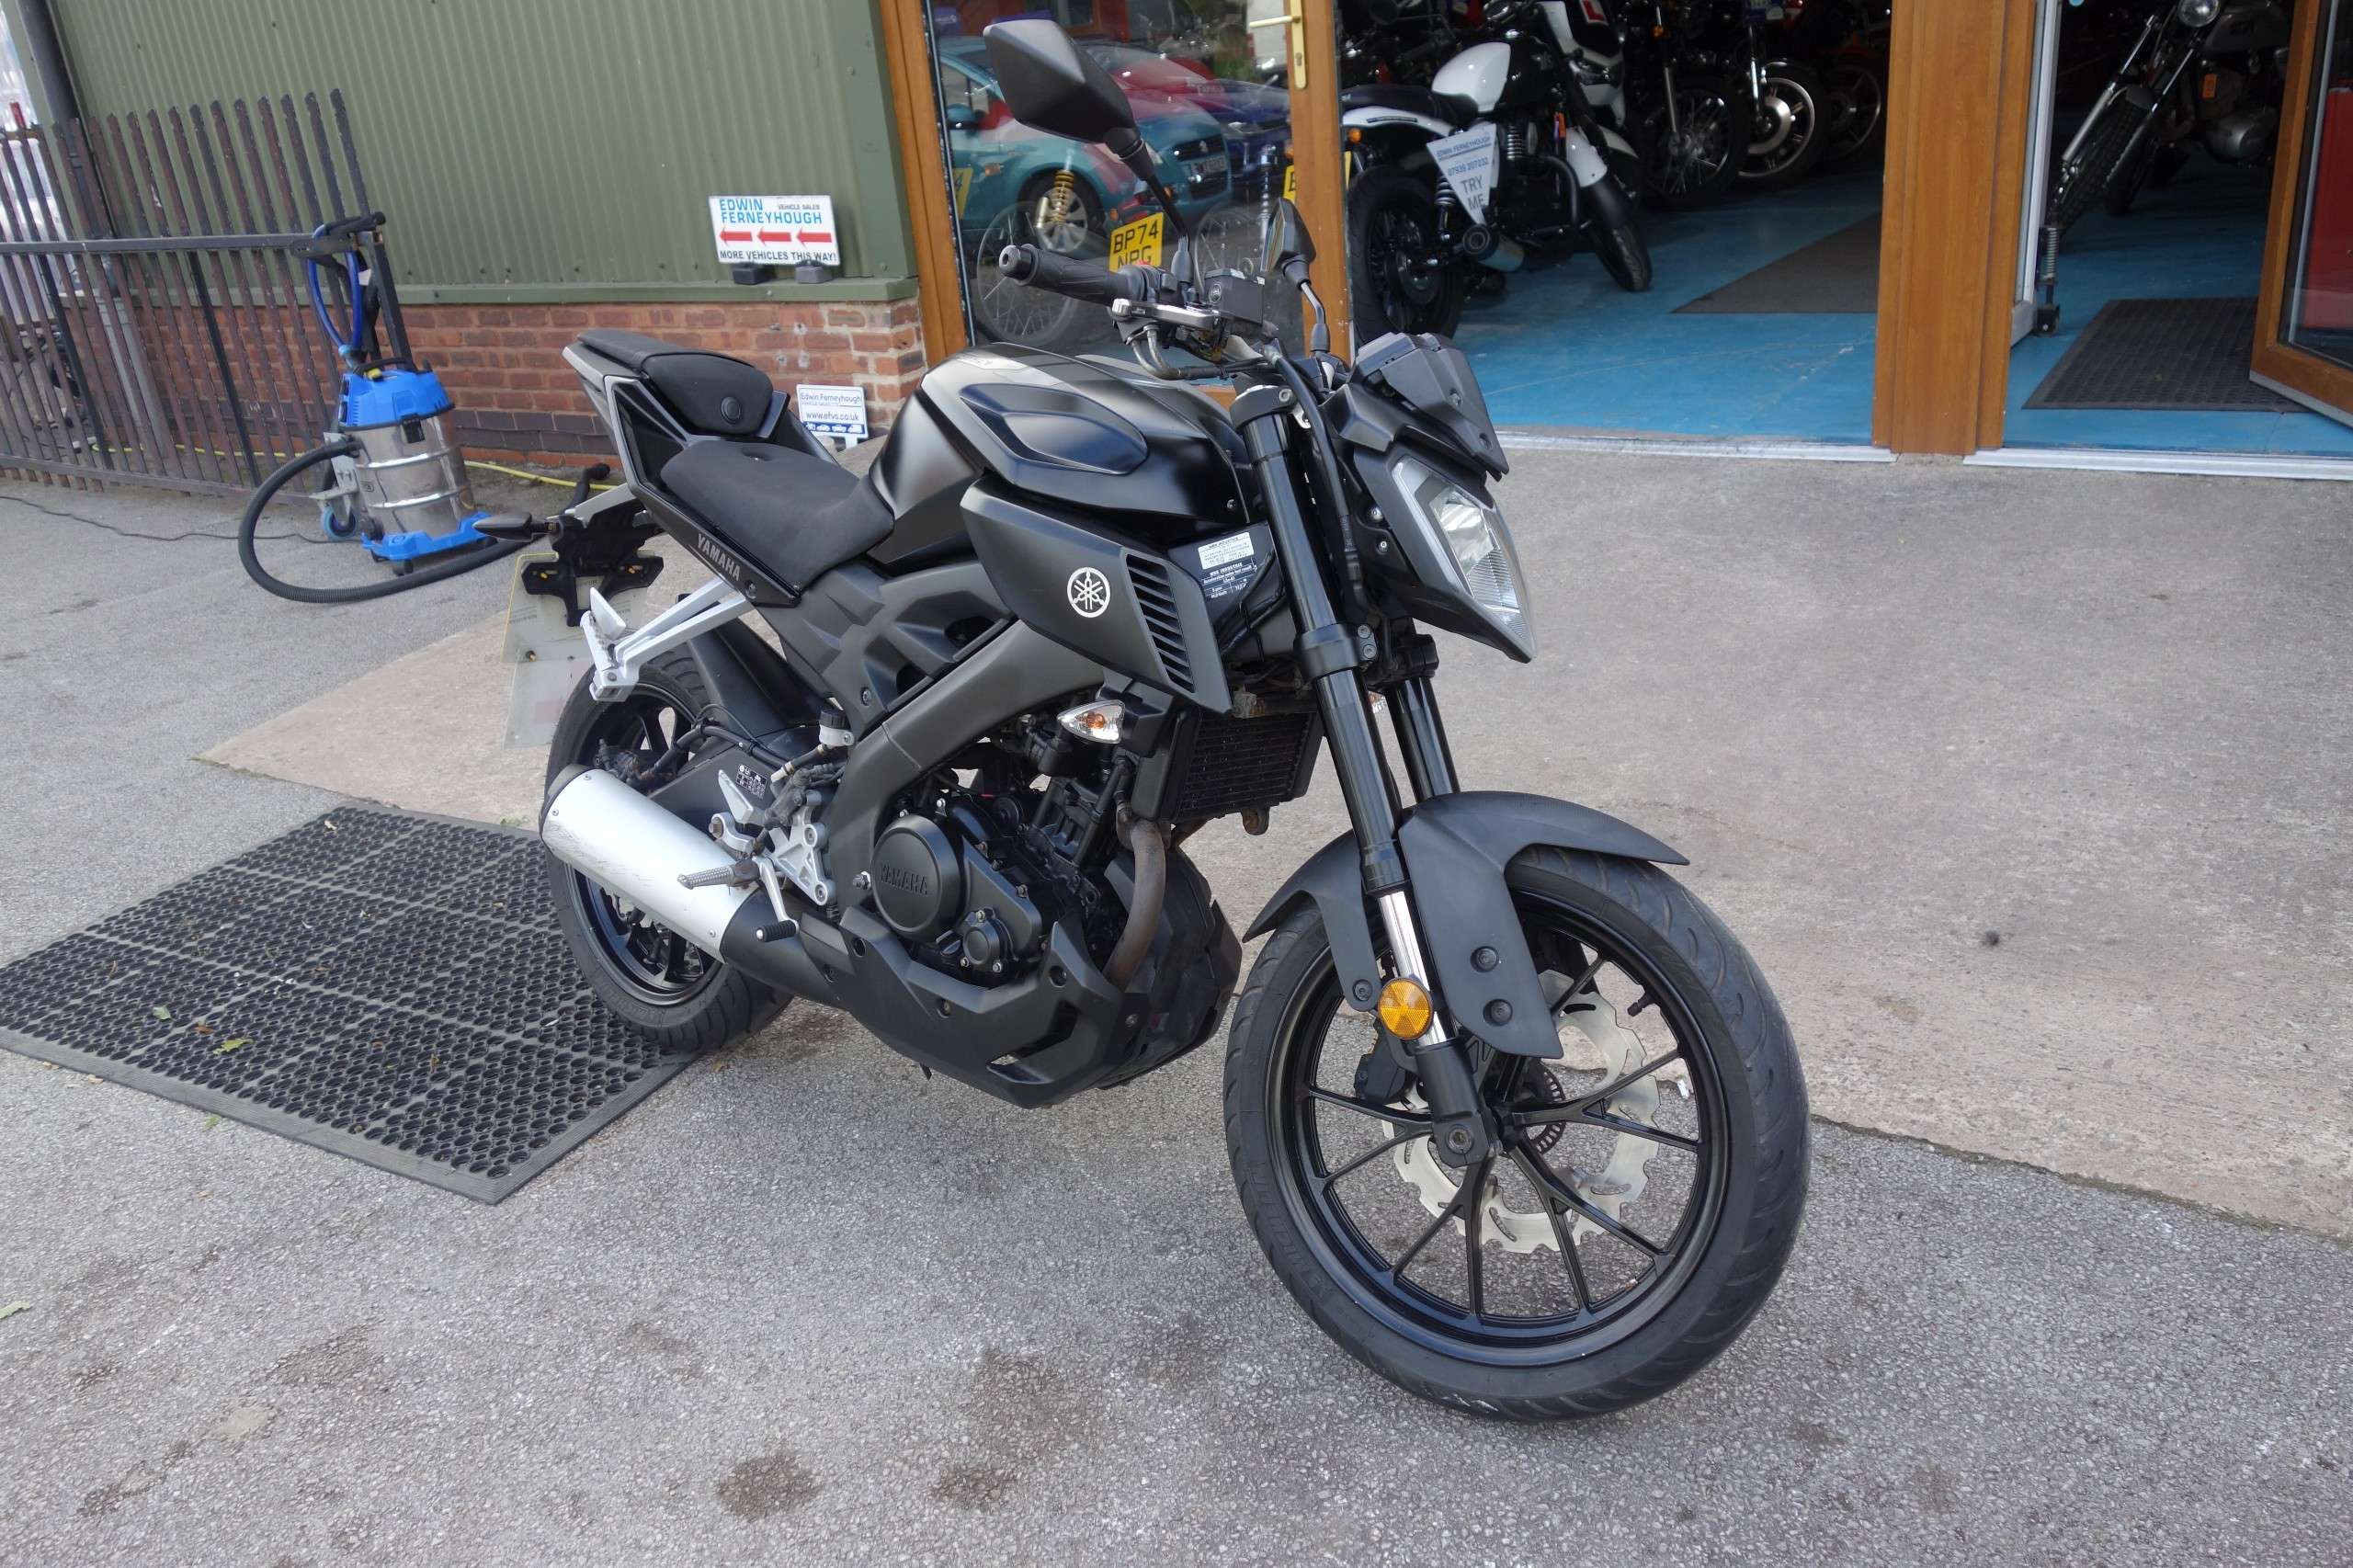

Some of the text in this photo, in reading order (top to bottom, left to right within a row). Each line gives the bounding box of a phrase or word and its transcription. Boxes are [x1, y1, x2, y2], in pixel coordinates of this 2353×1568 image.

[1461, 176, 1483, 194] TRY
[720, 199, 763, 211] EDWIN
[1468, 193, 1485, 210] ME
[722, 211, 823, 224] FERNEYHOUGH
[1113, 219, 1159, 255] BP74
[720, 250, 837, 262] MORE VEHICLES THIS WAY!
[820, 392, 861, 403] Ferneyhough
[698, 533, 741, 581] YAMAHA
[881, 863, 928, 896] YAMAHA
